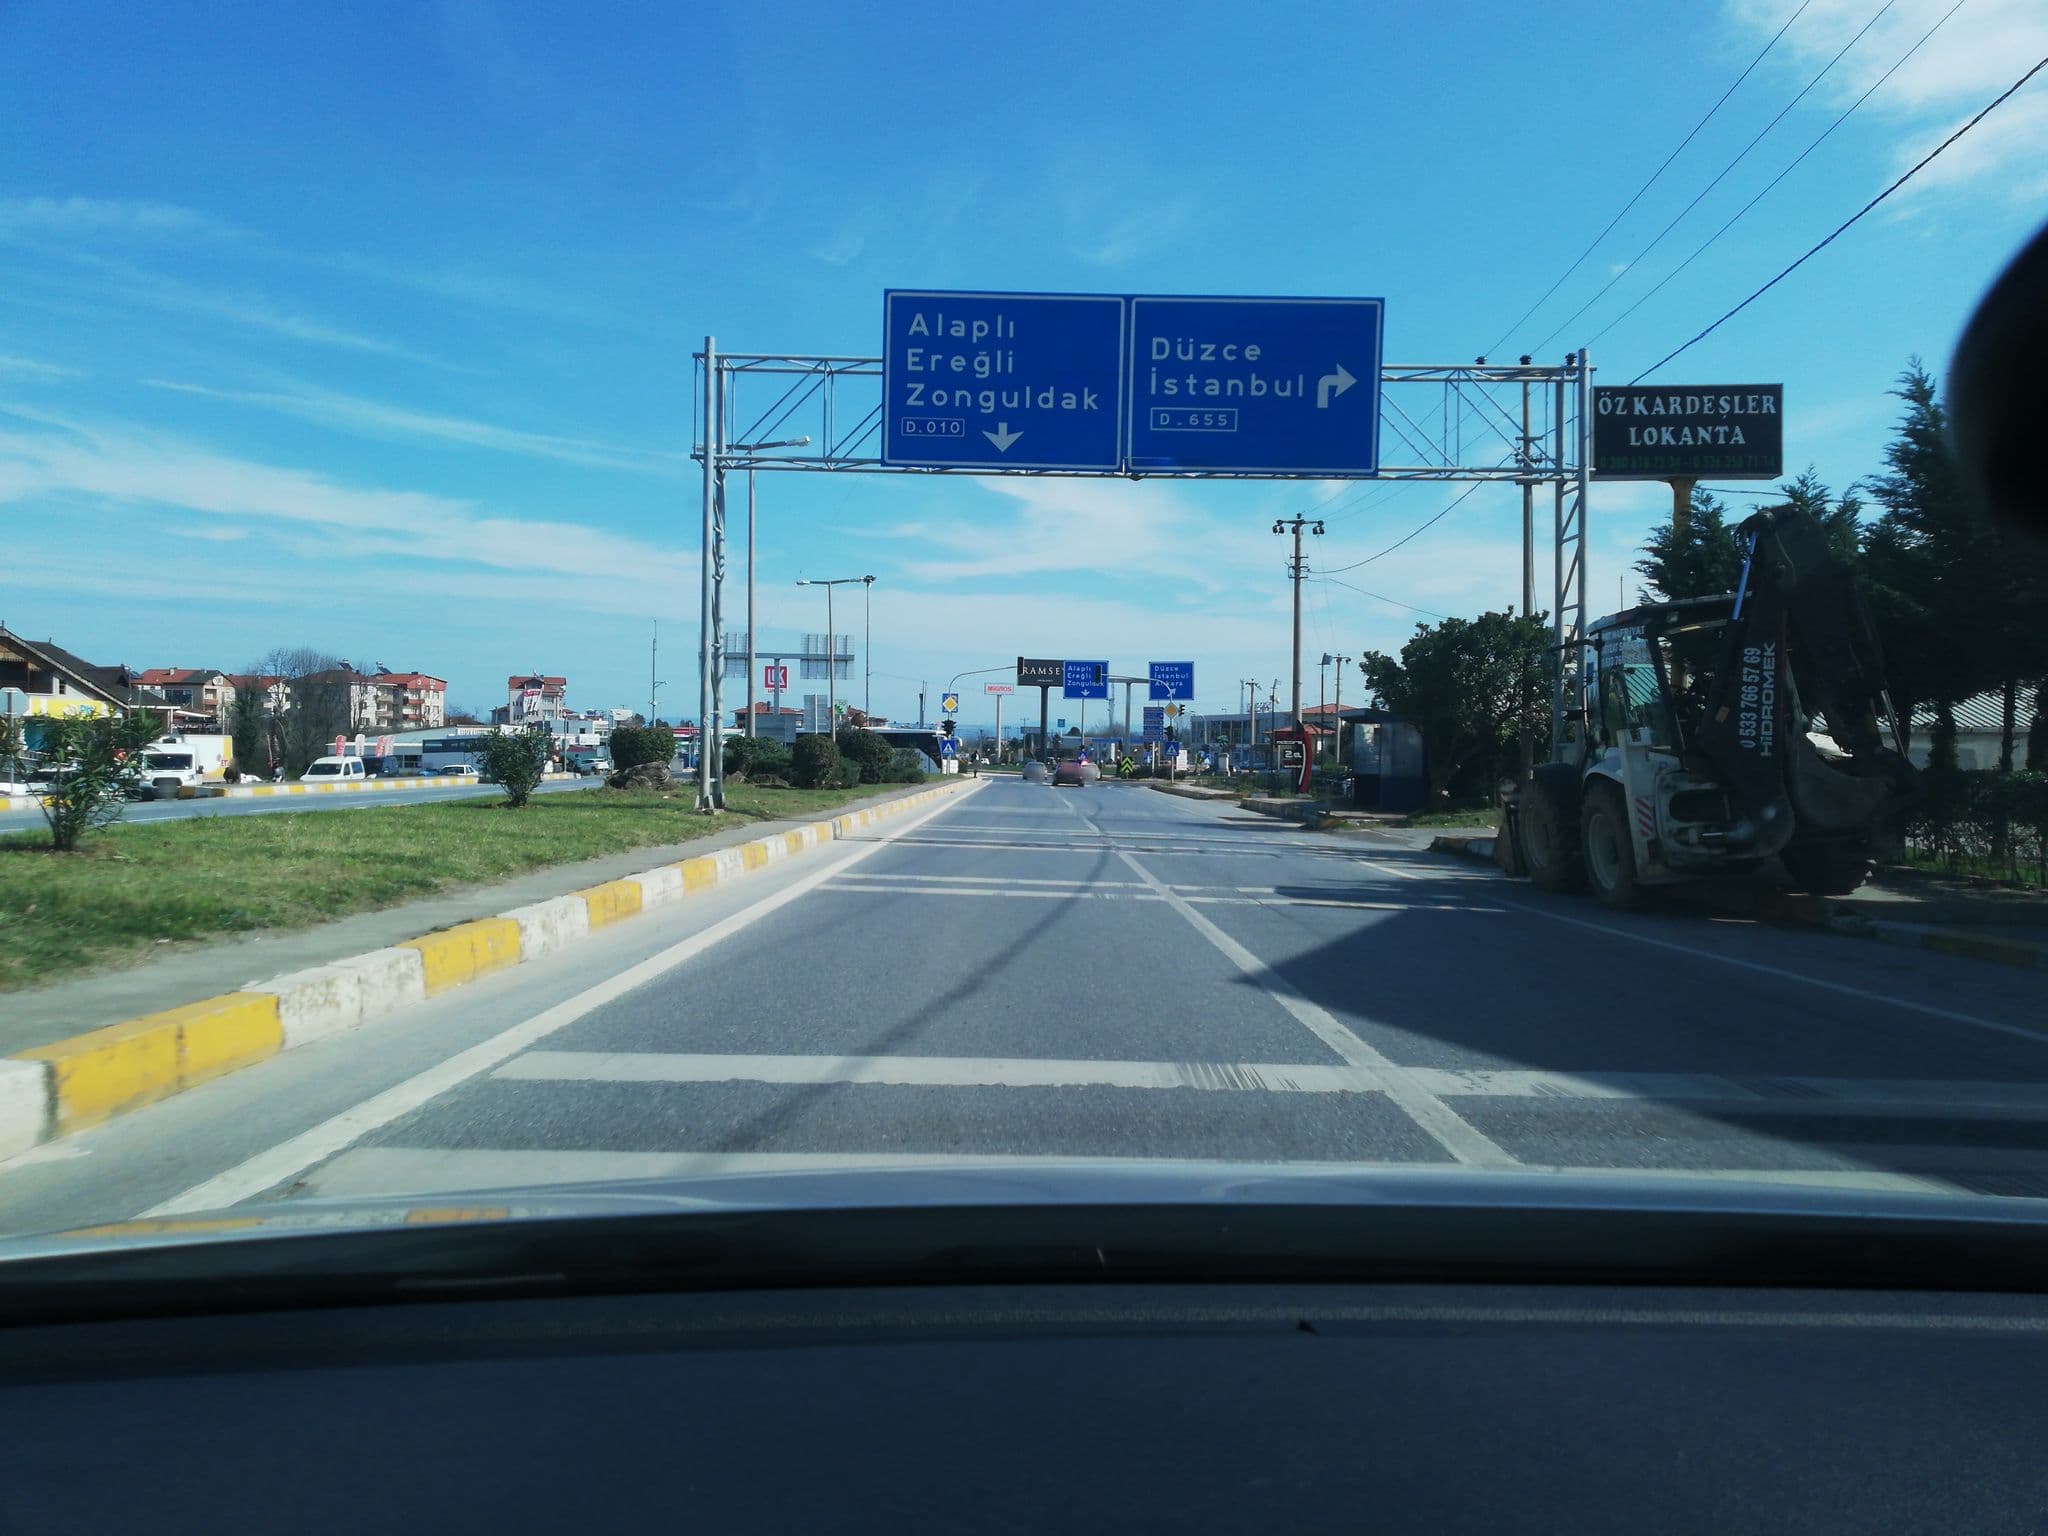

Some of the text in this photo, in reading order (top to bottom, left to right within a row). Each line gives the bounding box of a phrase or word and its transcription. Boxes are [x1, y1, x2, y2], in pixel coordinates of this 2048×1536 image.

[908, 312, 1015, 343] Alaplı
[1151, 336, 1262, 361] Düzce
[906, 348, 1014, 379] Ereğli
[1150, 367, 1304, 397] İstanbul
[905, 382, 1099, 413] Zonguldak
[1598, 391, 1777, 419] ÖZ KARDEŞLER
[905, 420, 961, 434] D.010
[1629, 425, 1746, 446] LOKANTA
[1744, 647, 1761, 664] 69
[1022, 666, 1064, 676] RAMSE
[1742, 666, 1760, 683] 57
[1741, 685, 1759, 709] 766
[1740, 712, 1757, 737] 533
